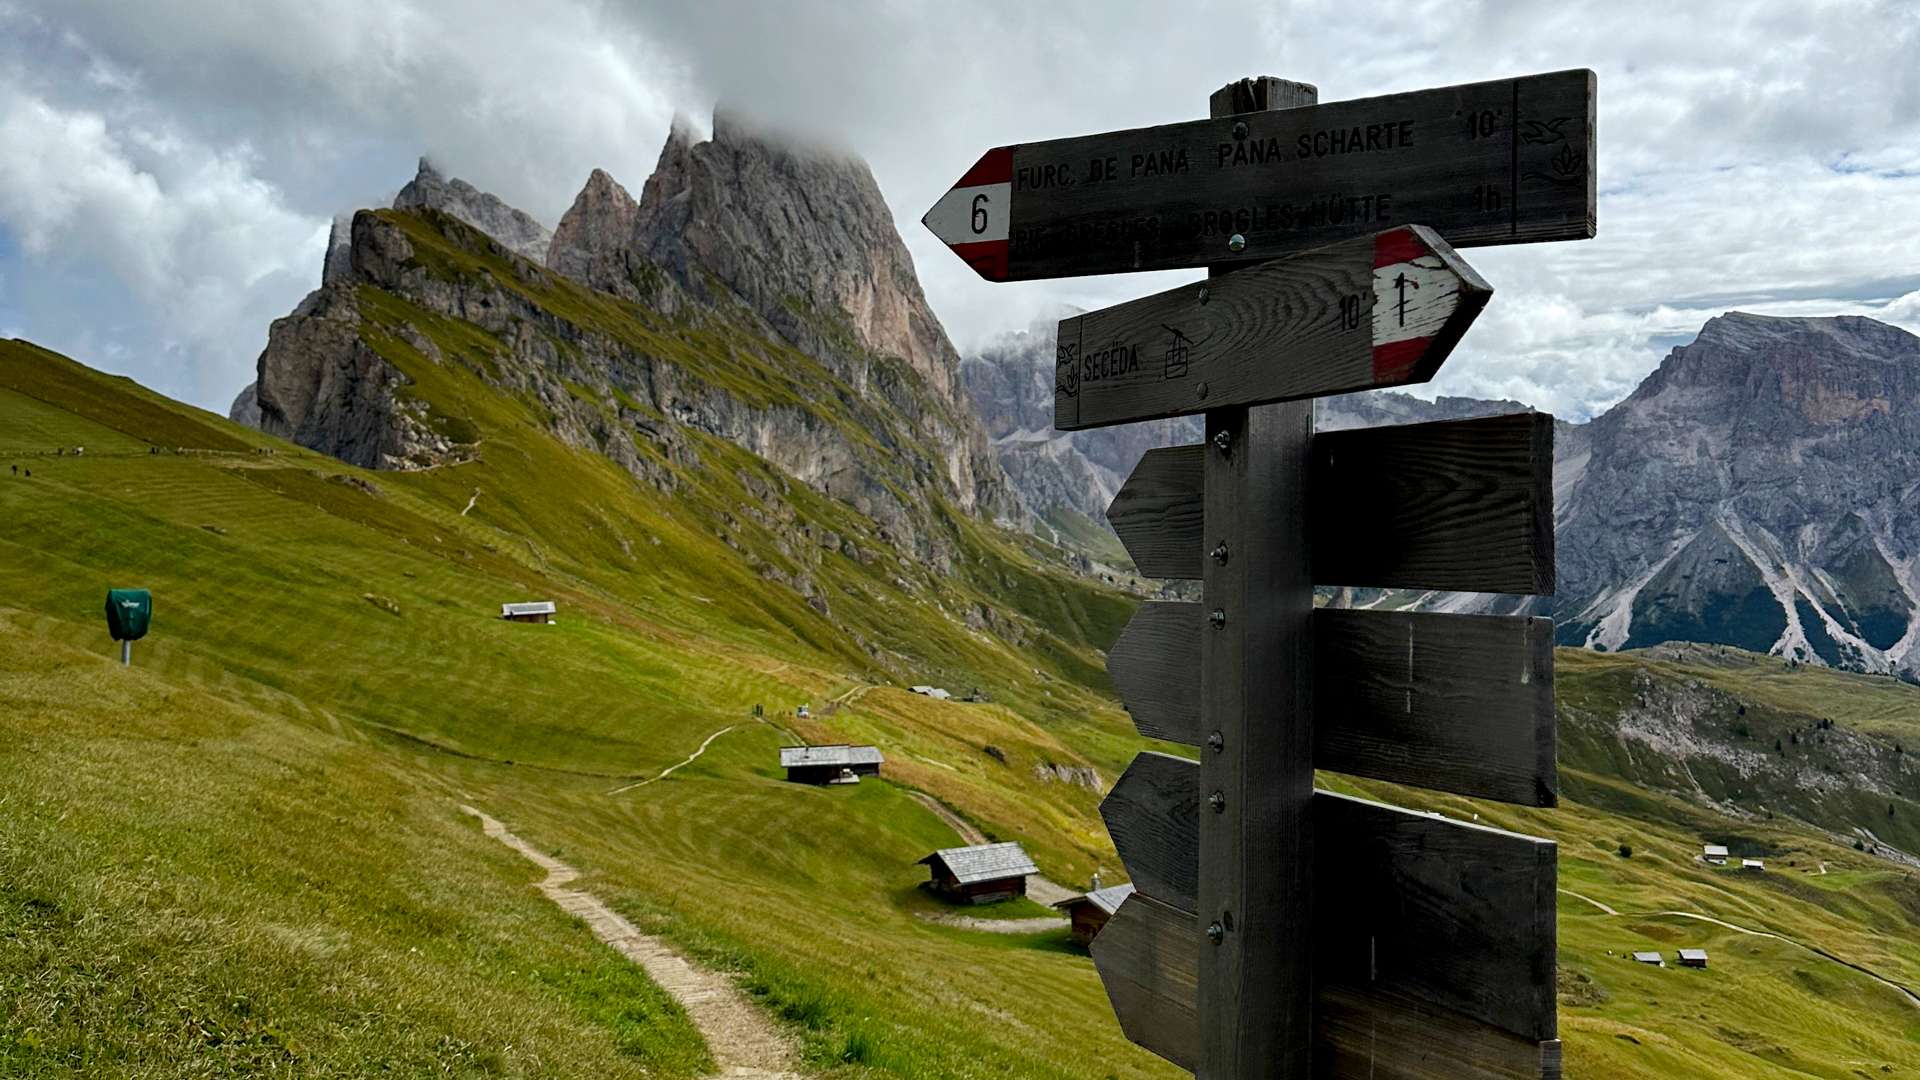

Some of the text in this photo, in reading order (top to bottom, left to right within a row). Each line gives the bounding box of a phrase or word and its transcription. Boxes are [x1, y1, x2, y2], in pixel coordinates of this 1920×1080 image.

[1296, 120, 1416, 158] SCHARTE
[1089, 156, 1118, 183] DE
[971, 193, 989, 235] 6
